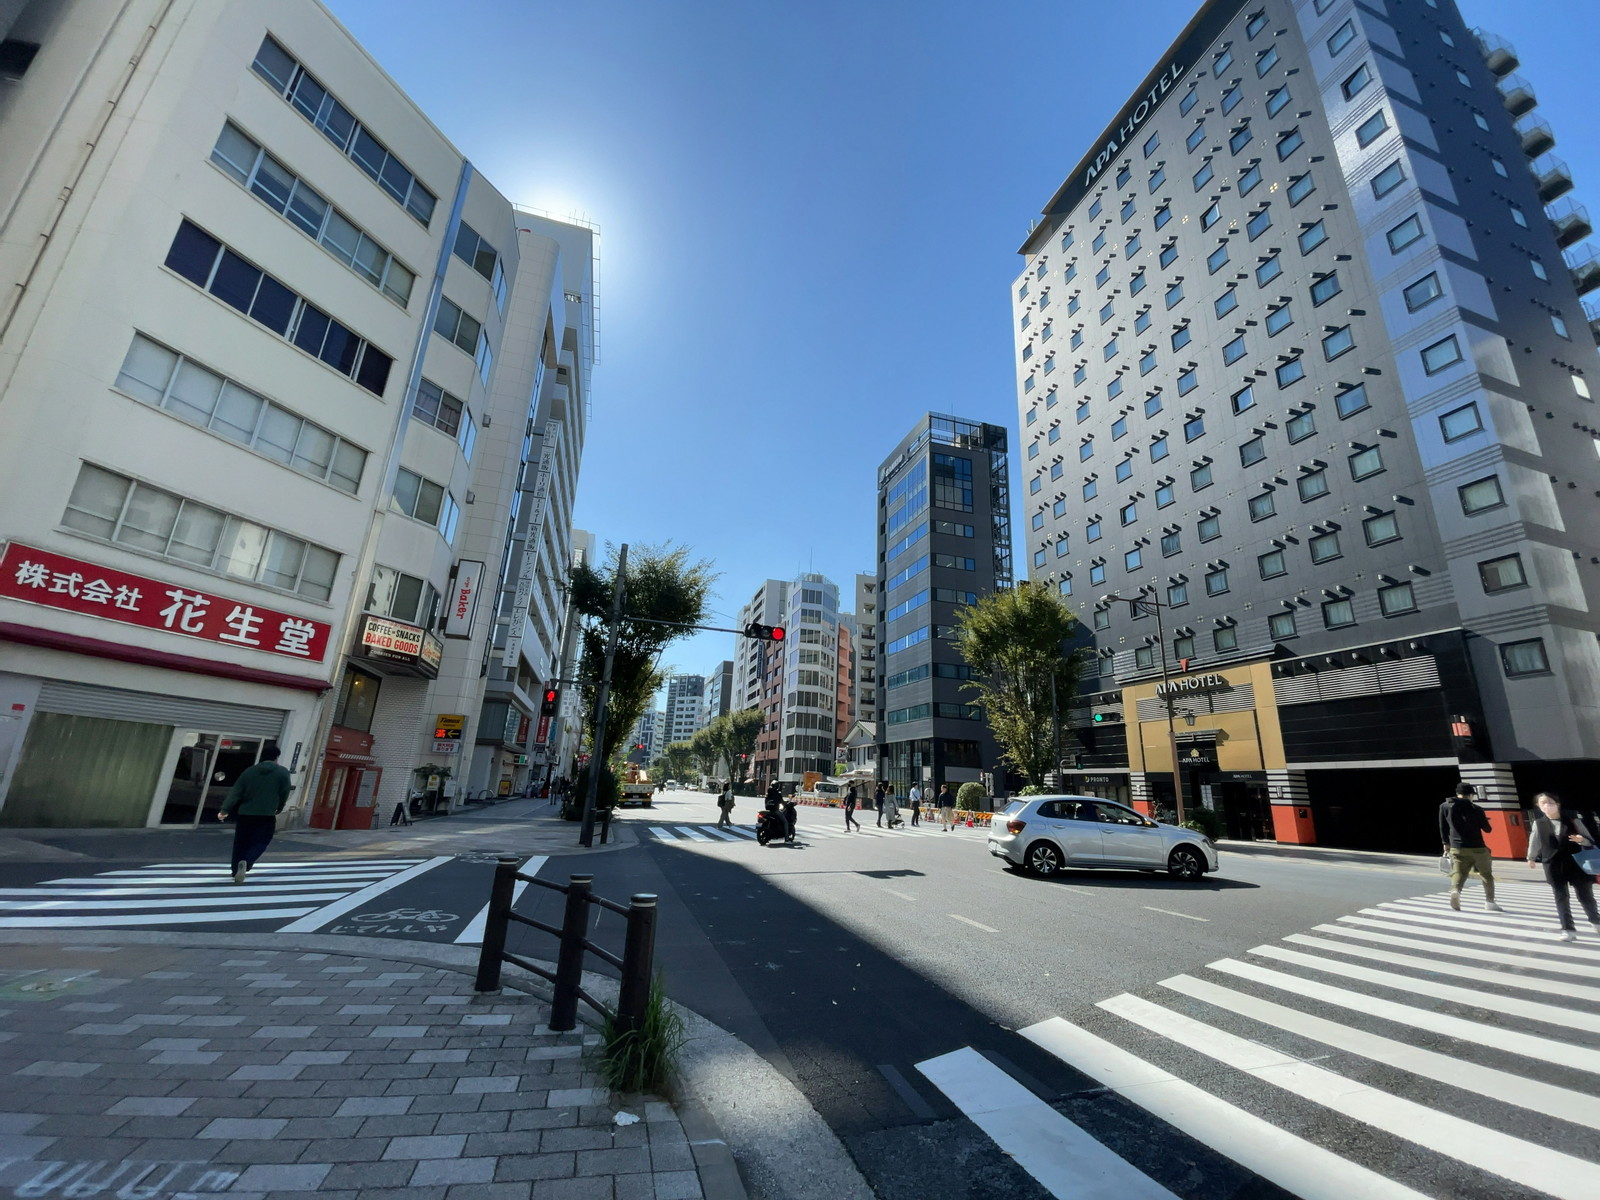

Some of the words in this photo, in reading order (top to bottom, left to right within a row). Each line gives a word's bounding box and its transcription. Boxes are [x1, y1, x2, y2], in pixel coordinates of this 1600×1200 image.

[1084, 140, 1118, 187] APA
[1119, 62, 1184, 143] HOTEL
[14, 560, 143, 611] 株式会社
[159, 589, 315, 656] 花生堂
[456, 588, 472, 620] Baker
[365, 632, 392, 648] BAKED
[394, 639, 419, 654] GOODS
[368, 622, 392, 635] COFFEE
[396, 629, 421, 643] SNACKS
[1180, 674, 1222, 691] HOTEL
